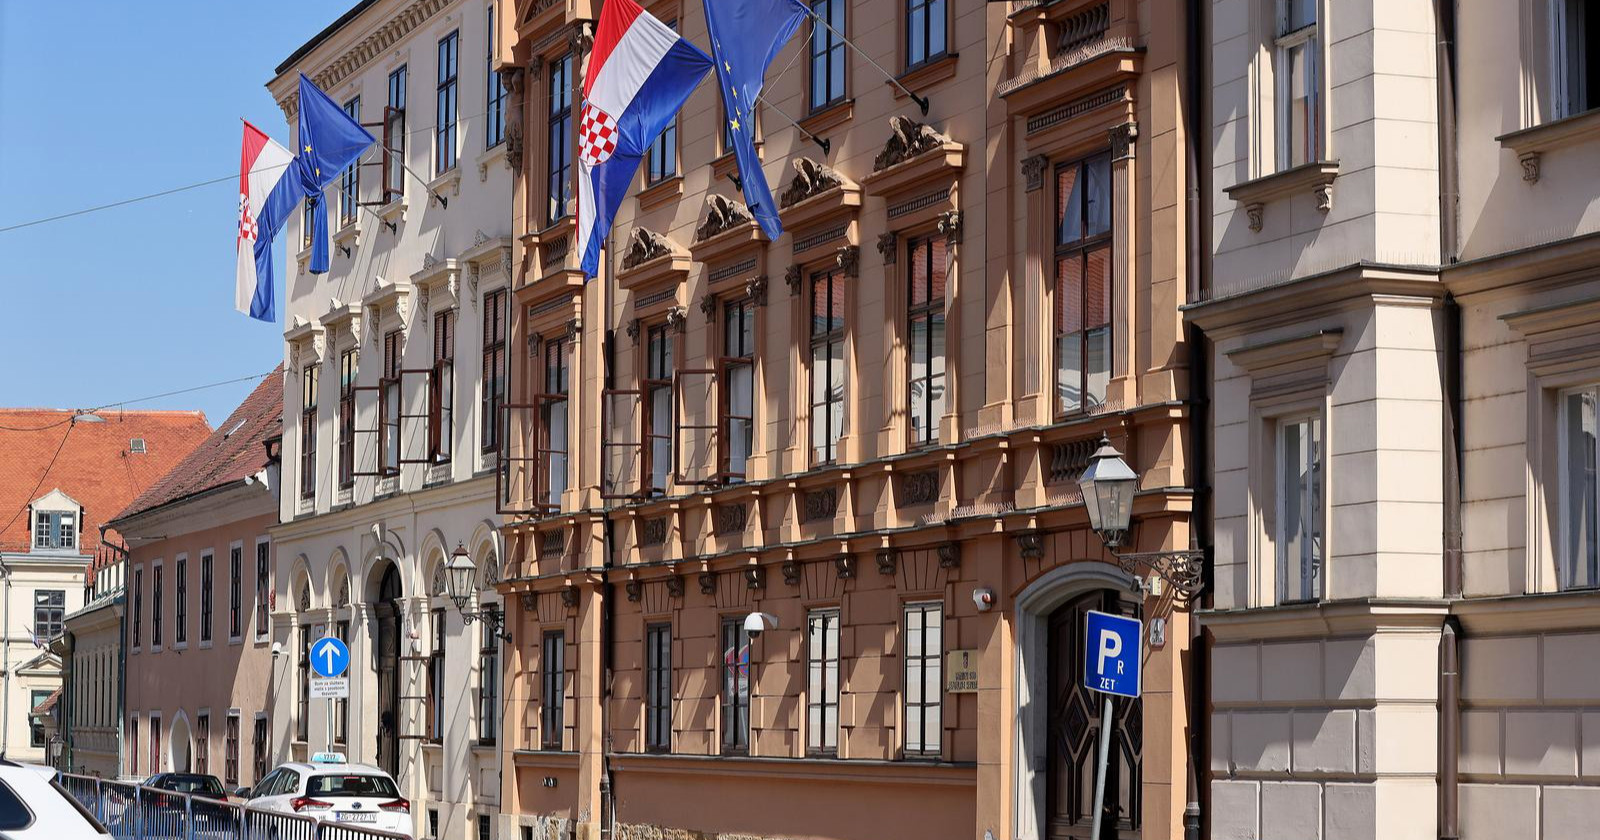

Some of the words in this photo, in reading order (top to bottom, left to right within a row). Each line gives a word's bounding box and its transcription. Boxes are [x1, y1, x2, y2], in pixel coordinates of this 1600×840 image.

[1097, 628, 1123, 675] P
[1117, 659, 1125, 675] R
[1099, 677, 1116, 691] ZET
